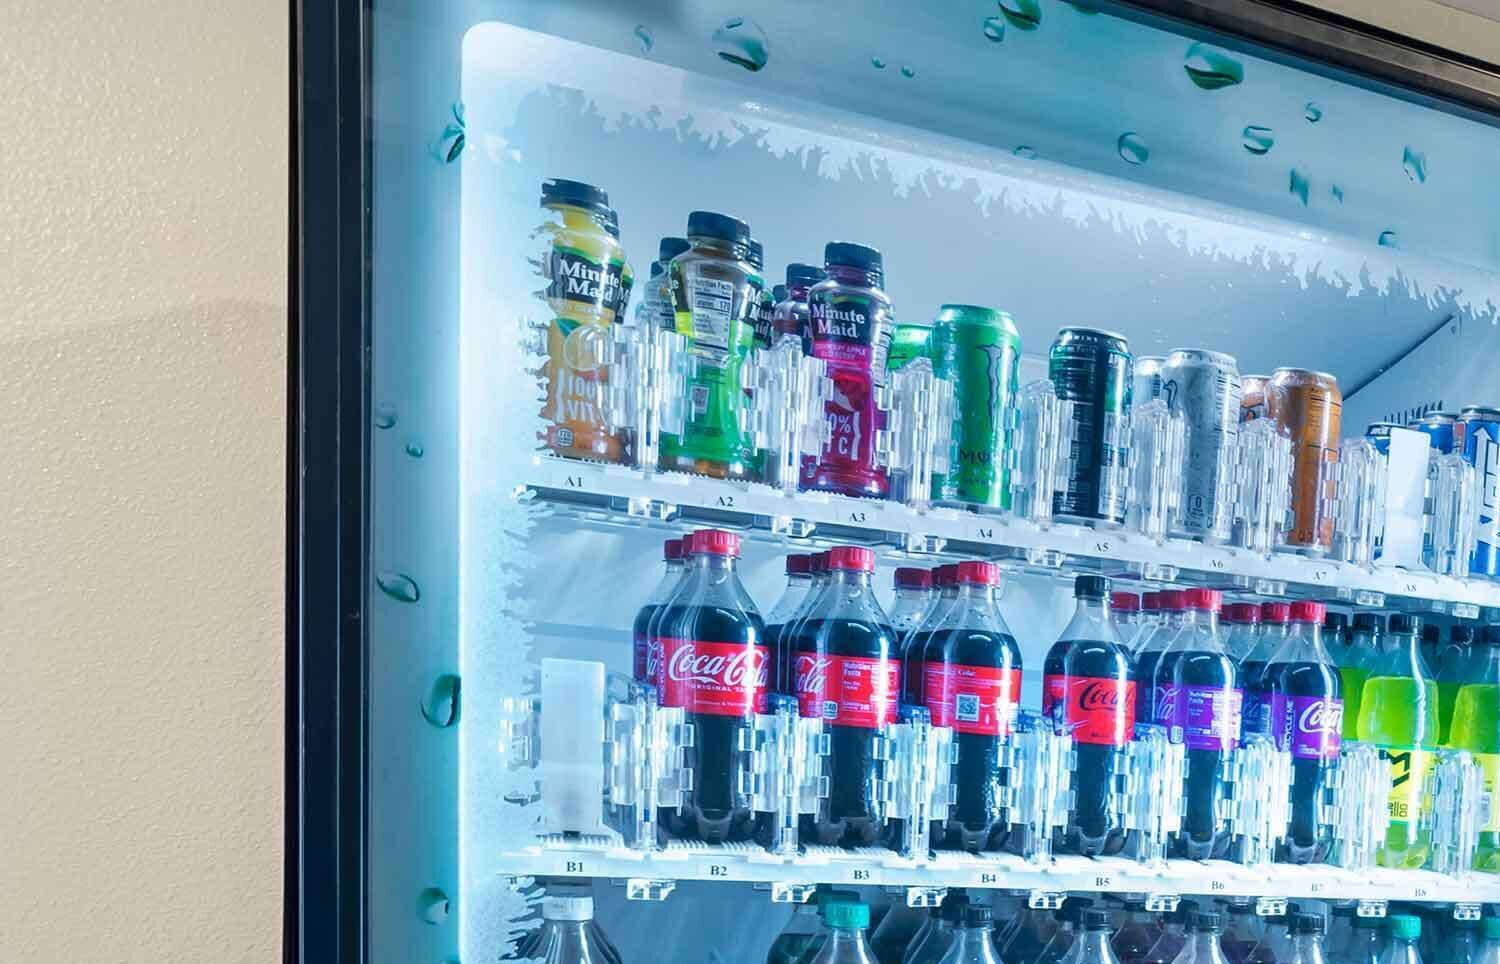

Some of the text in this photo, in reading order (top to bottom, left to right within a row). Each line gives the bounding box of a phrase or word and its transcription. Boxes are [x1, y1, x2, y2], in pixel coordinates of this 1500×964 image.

[567, 277, 613, 302] Mad
[812, 303, 865, 324] Minute
[818, 319, 858, 338] Maid
[564, 476, 582, 488] A1
[716, 496, 733, 507] A2
[850, 512, 866, 523] A3
[977, 528, 992, 539] A4
[566, 860, 584, 874] B1
[710, 865, 728, 877] B2
[854, 869, 870, 881] B3
[981, 873, 996, 884] B4
[1095, 876, 1110, 887] B5
[1211, 880, 1225, 890] B6
